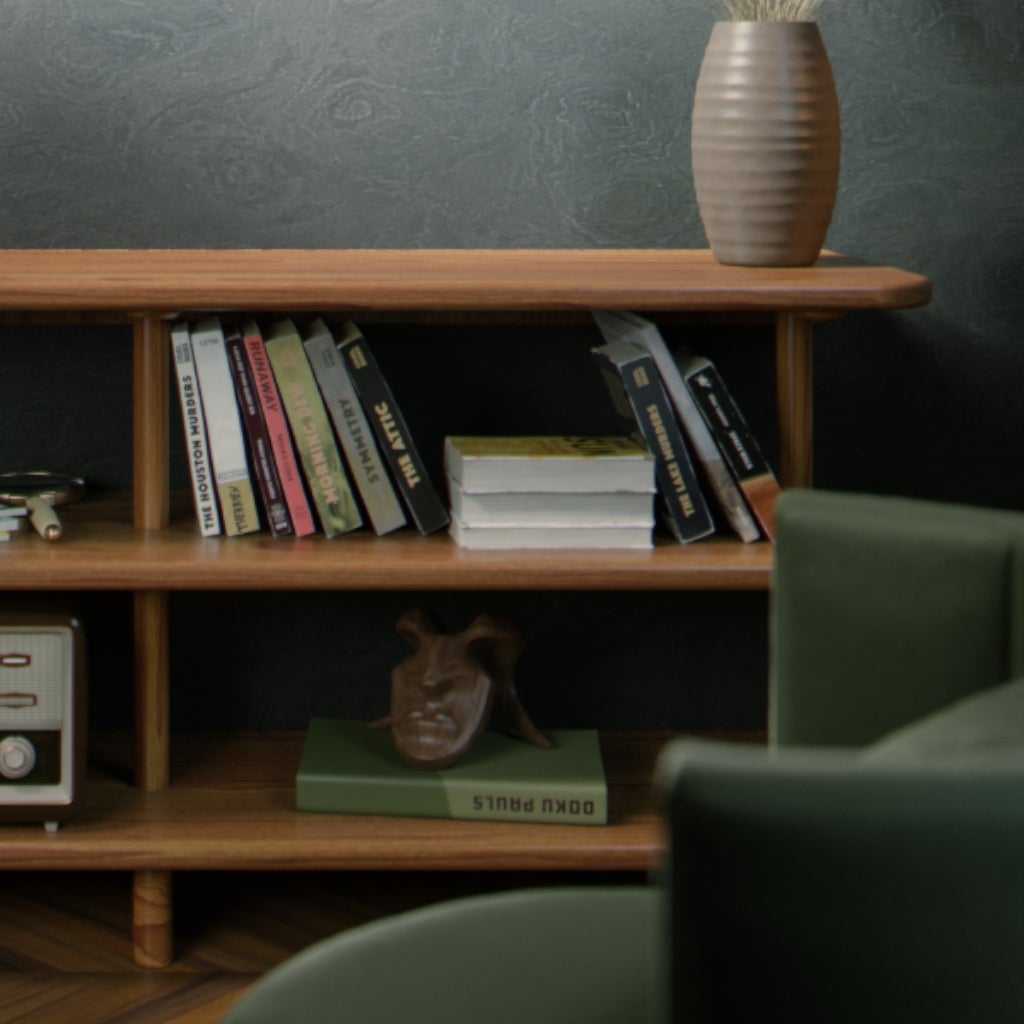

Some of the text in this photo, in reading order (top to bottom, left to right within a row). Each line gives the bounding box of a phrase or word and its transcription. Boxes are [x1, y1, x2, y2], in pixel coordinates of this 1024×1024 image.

[183, 374, 200, 435] MURDERS
[250, 341, 277, 413] RUNAWAY
[192, 440, 209, 500] HOUSTON
[288, 380, 338, 504] MORNING DEW
[338, 398, 379, 484] SYMMETRY
[374, 401, 421, 488] THE ATTIC
[646, 403, 695, 518] THE LAKE MURDERS
[203, 507, 215, 530] THE
[473, 795, 594, 815] DOKU PAULS
